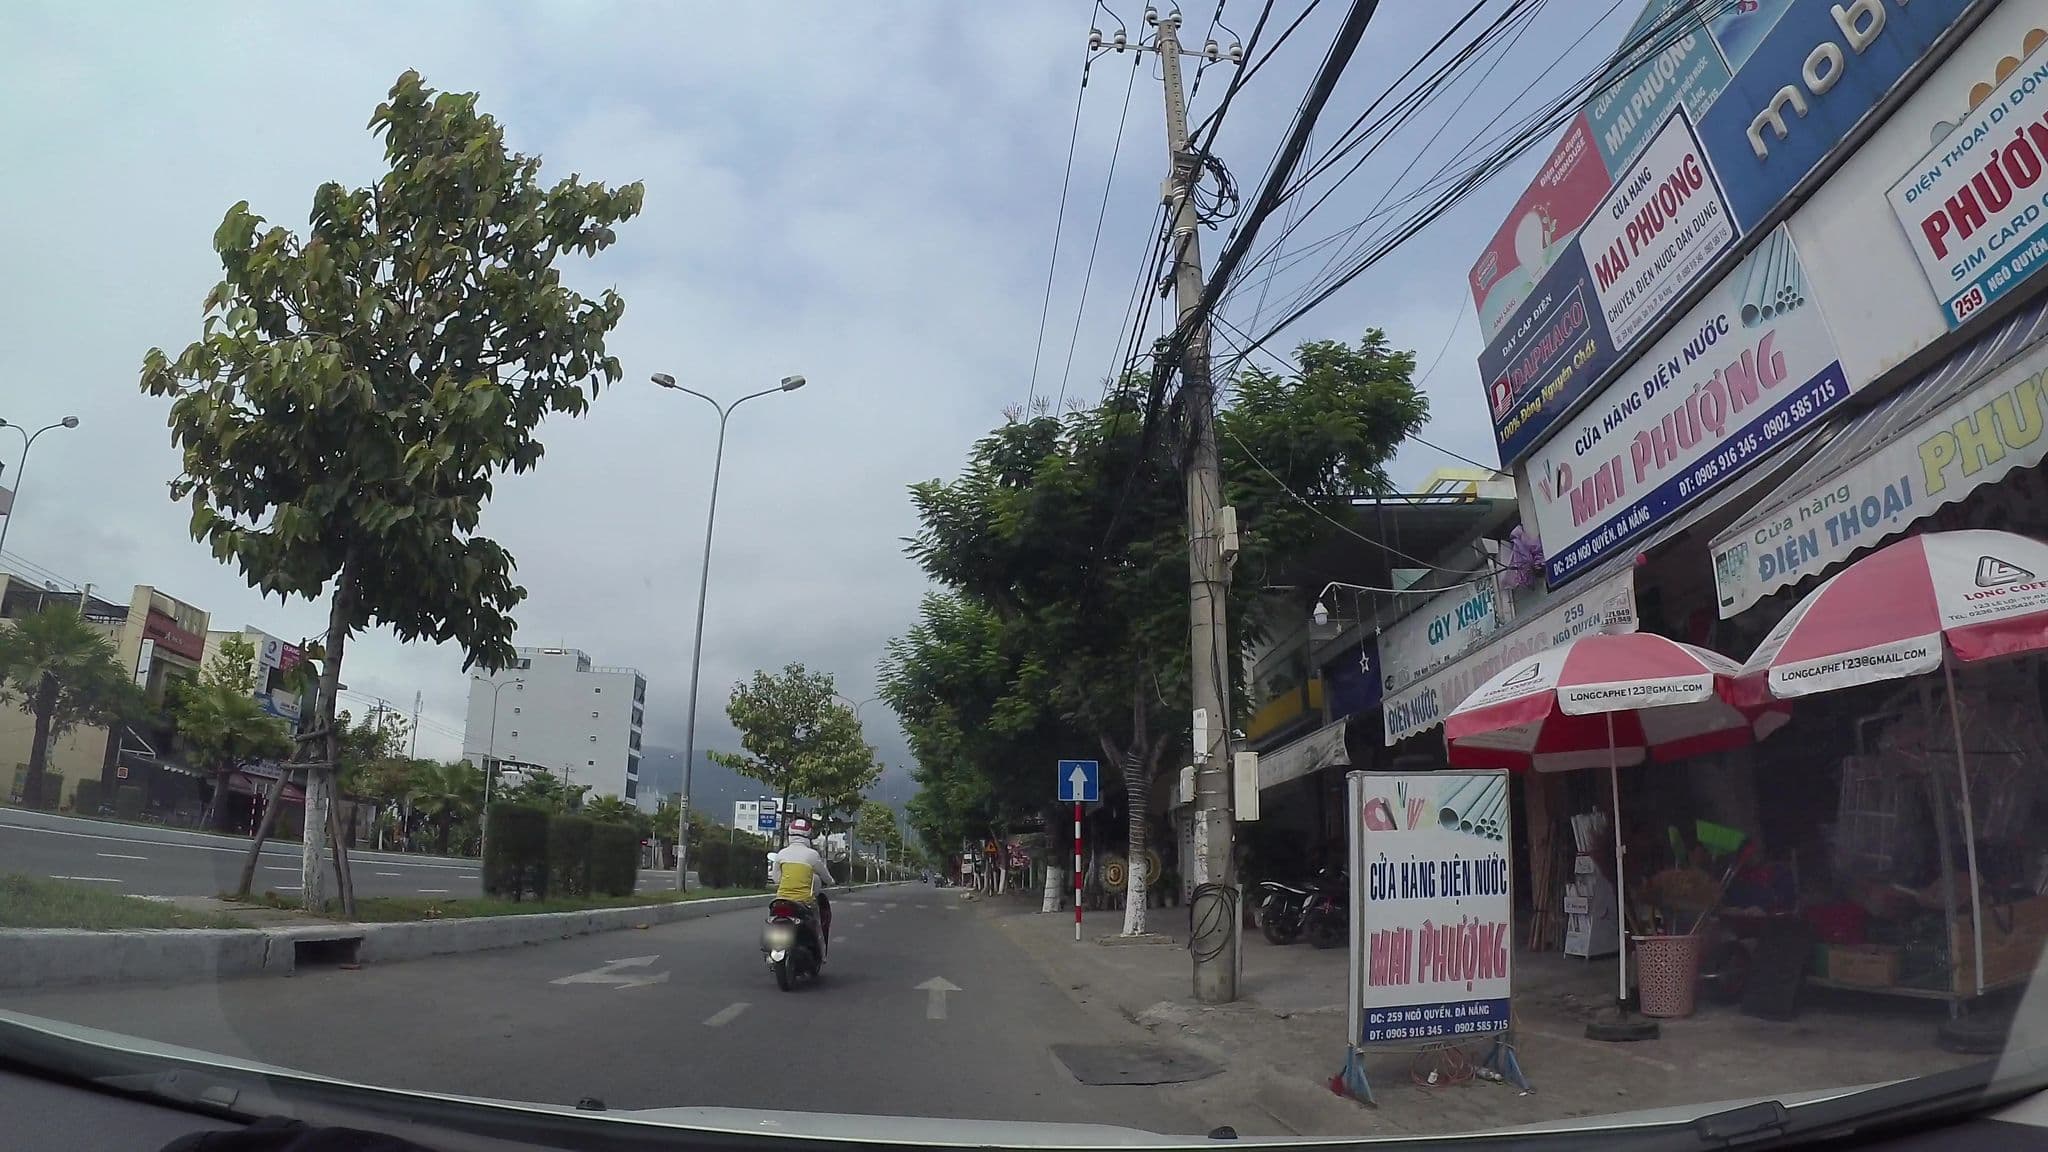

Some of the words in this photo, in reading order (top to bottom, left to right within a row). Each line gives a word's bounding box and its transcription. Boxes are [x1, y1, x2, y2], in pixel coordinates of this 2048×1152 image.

[1604, 106, 1637, 155] MAI
[1631, 33, 1697, 120] PHƯỢNG
[1747, 0, 1907, 160] mob
[1904, 166, 1942, 203] ĐIỆN
[1941, 121, 1989, 168] THOẠI
[1989, 102, 2009, 124] DI
[2010, 61, 2048, 106] ĐỘN
[1551, 136, 1586, 187] SUNHOUSE
[1594, 237, 1630, 293] MAI
[1625, 153, 1703, 257] PHƯỢNG
[1694, 200, 1718, 232] DỤNG
[1951, 247, 1987, 281] SIM
[1988, 205, 2040, 250] CARD
[1955, 287, 1983, 318] 259
[1510, 301, 1584, 394] DAPHACO
[1574, 420, 1602, 456] CỬA
[1602, 391, 1642, 436] HÀNG
[1642, 356, 1682, 400] ĐIỆN
[1681, 314, 1729, 367] NƯỚC
[1500, 418, 1521, 444] 100%
[1569, 454, 1626, 528] MAI
[1630, 329, 1788, 484] PHƯỢNG
[1679, 477, 1696, 497] ĐT:
[1694, 459, 1718, 487] 0905
[1718, 446, 1738, 471] 916
[1737, 433, 1758, 458] 345
[1762, 411, 1792, 440] 0902
[1790, 395, 1812, 422] 585
[1812, 378, 1836, 407] 715
[1758, 528, 1820, 582] ĐIỆN
[1825, 475, 1913, 547] THOẠI
[1799, 484, 1851, 523] hàng
[1564, 552, 1578, 569] 259
[1616, 516, 1629, 537] ĐÀ
[1564, 603, 1585, 623] 259
[1964, 588, 2006, 601] LONG
[1428, 614, 1450, 645] CÂY
[1782, 648, 1926, 682] LONGCAPHE123@GMAIL.COM
[1413, 686, 1439, 726] NƯỚC
[1570, 683, 1703, 701] LONGCAPHE123@GMAIL.COM
[1370, 852, 1397, 901] CỬA
[1401, 854, 1436, 899] HÀNG
[1440, 853, 1471, 905] ĐIỆN
[1475, 852, 1507, 896] NƯỚC
[1368, 927, 1413, 987] MAI
[1418, 913, 1508, 992] PHƯỢNG
[1386, 1027, 1407, 1039] 0905
[1409, 1026, 1425, 1038] 916
[1427, 1024, 1442, 1036] 345
[1454, 1021, 1475, 1033] 0902
[1476, 1020, 1491, 1031] 585
[1493, 1019, 1509, 1030] 715
[1387, 1011, 1403, 1023] 259
[1404, 1009, 1421, 1021] NGÔ
